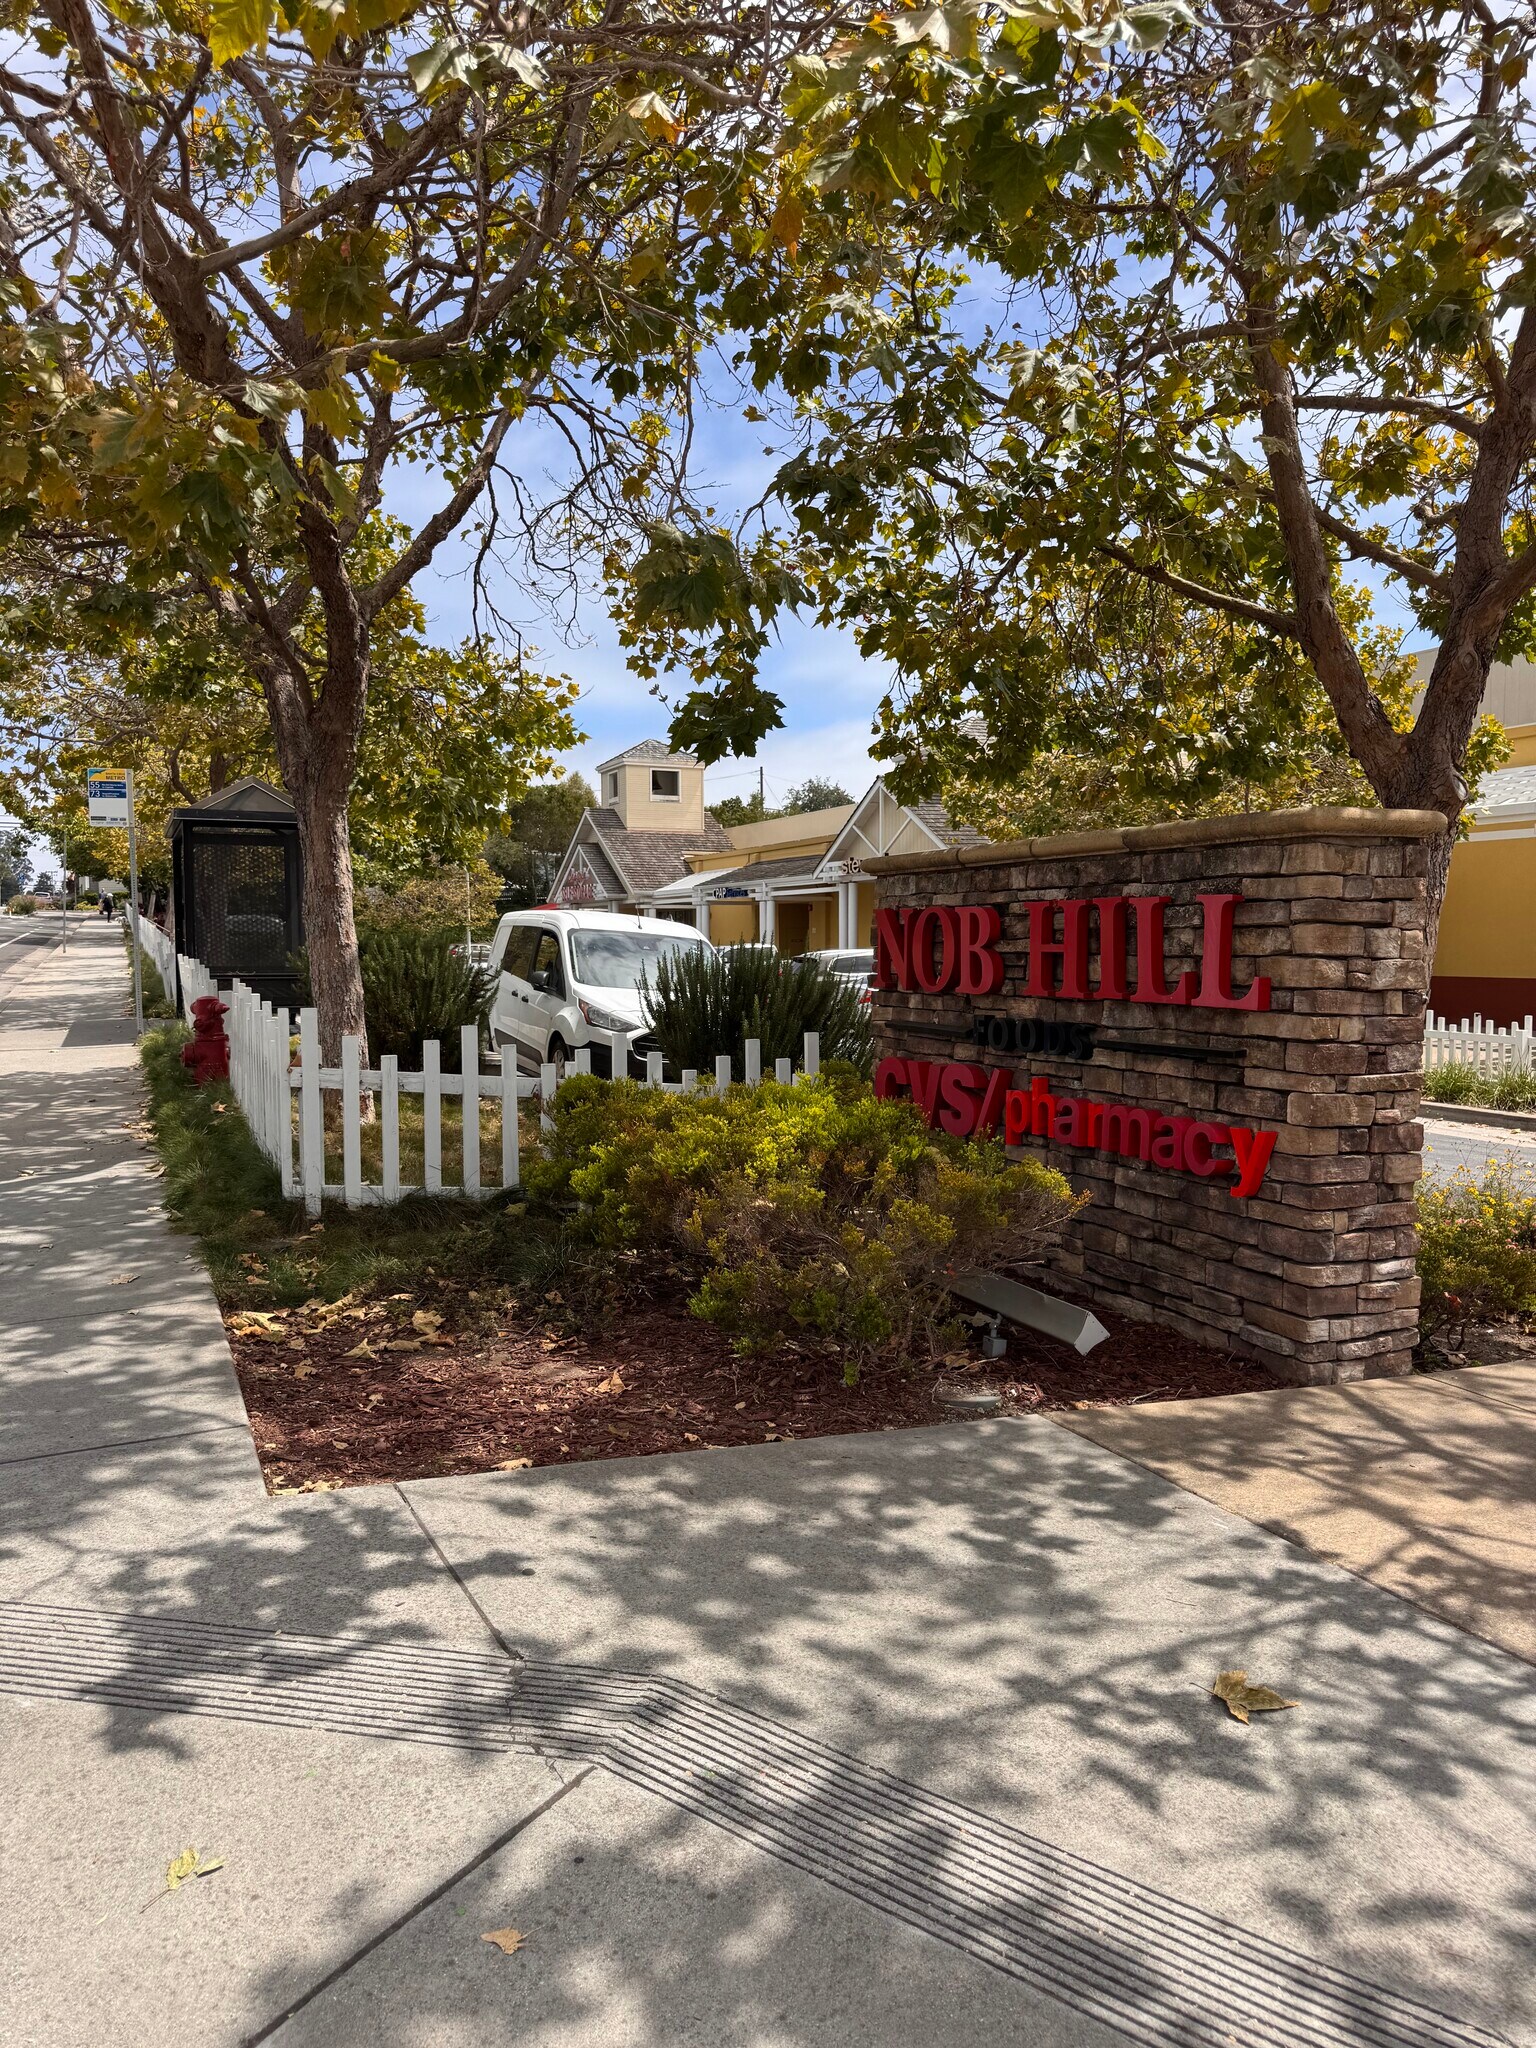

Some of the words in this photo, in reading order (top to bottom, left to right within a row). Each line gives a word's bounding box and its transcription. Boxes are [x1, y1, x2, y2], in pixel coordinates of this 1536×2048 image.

[841, 857, 861, 874] ste
[873, 905, 1004, 996] NOB
[1023, 894, 1271, 1011] HILL
[973, 1014, 1097, 1060] FOODS
